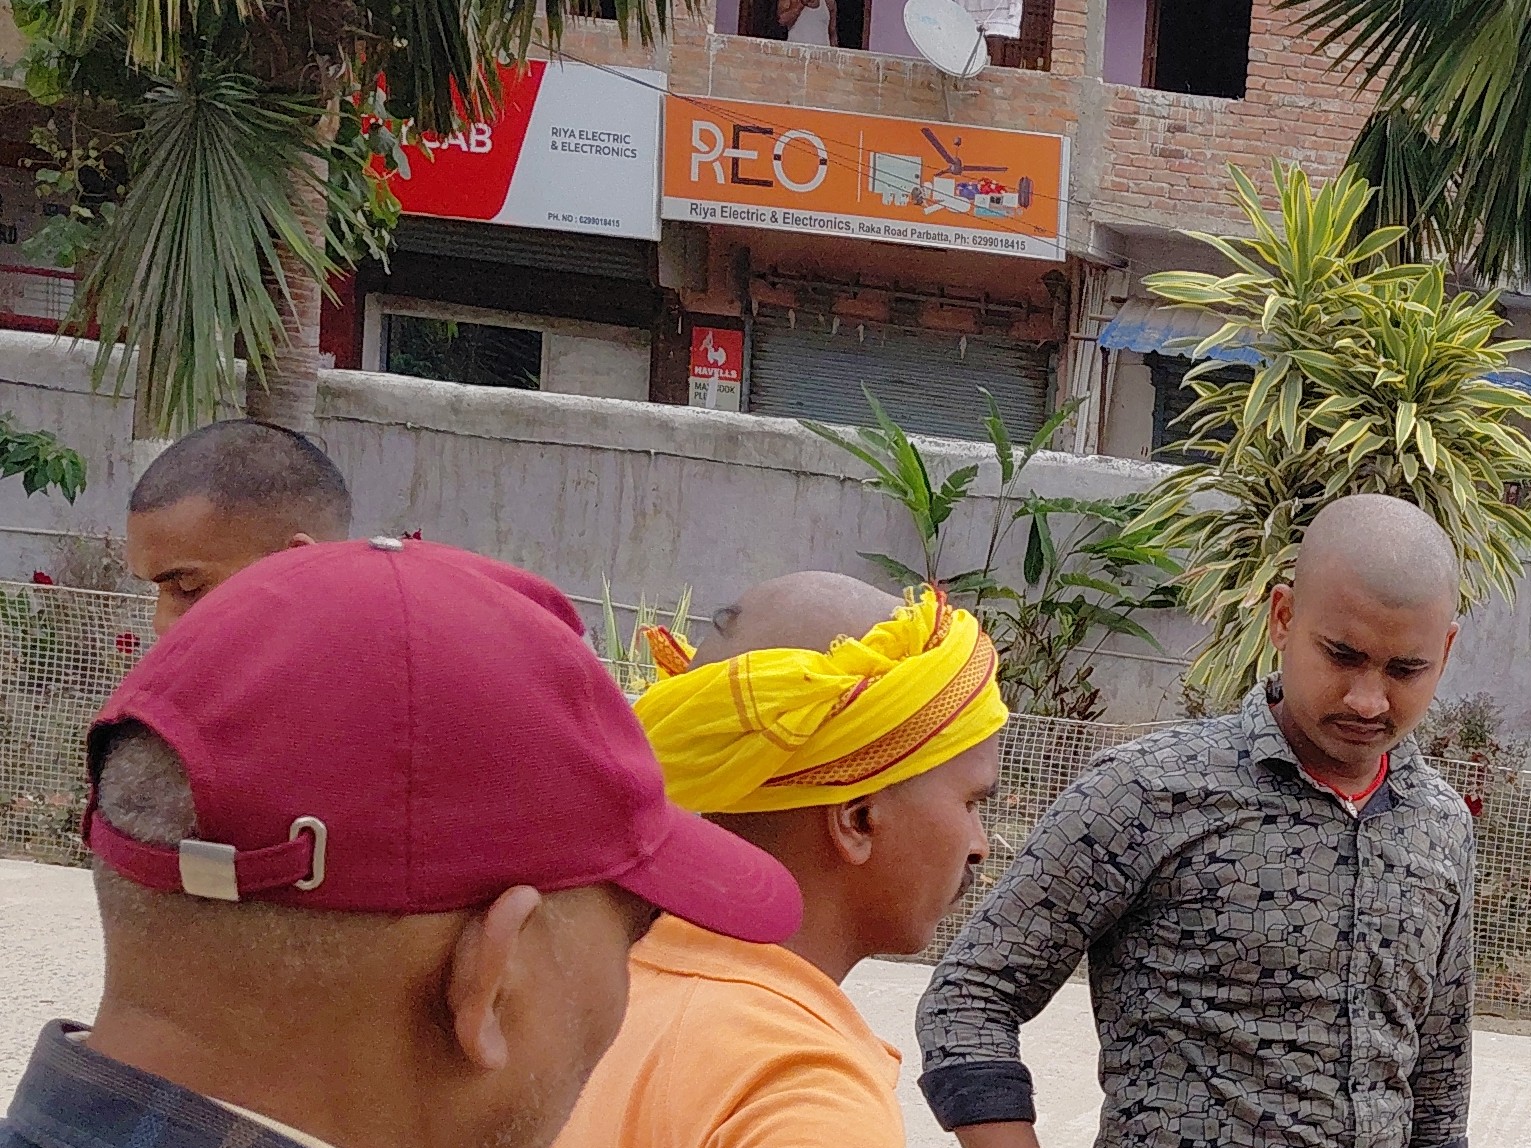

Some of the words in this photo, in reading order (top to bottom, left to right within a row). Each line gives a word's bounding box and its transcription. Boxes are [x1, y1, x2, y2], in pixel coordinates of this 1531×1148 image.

[550, 140, 558, 151] &
[561, 141, 637, 159] ELECTRONICS
[551, 127, 577, 139] RIYA
[578, 129, 631, 144] ELECTRIC
[691, 119, 828, 192] REO
[689, 202, 717, 219] Riya
[720, 205, 767, 223] Electric
[769, 210, 779, 224] &
[782, 212, 855, 234] Electronics,
[858, 222, 882, 235] Raka
[884, 225, 907, 238] Road
[910, 228, 952, 244] Parbatta,
[954, 233, 970, 245] Ph:
[972, 234, 1026, 251] 6299018415
